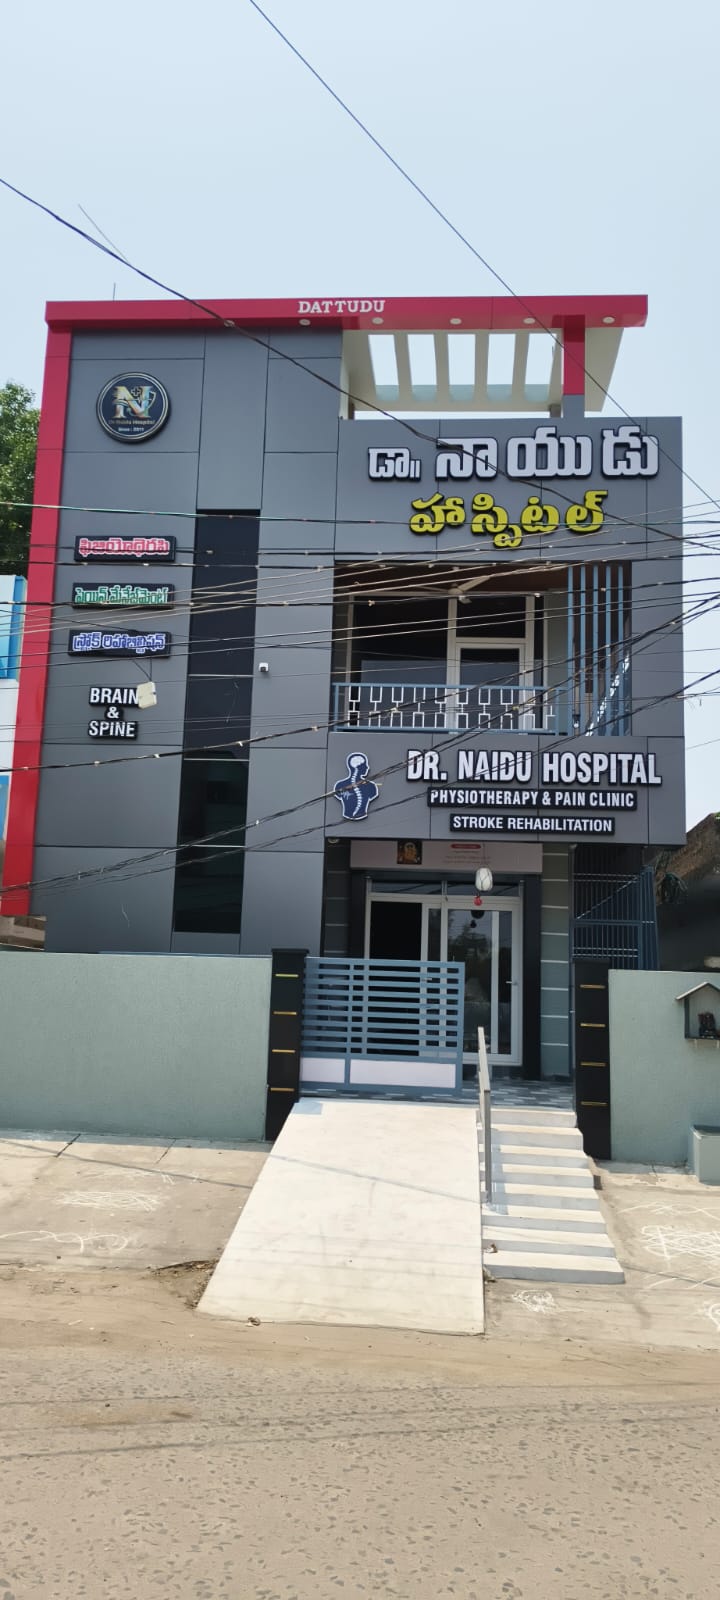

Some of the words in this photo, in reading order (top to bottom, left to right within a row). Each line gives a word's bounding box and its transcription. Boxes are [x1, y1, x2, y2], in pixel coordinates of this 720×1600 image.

[298, 300, 386, 313] DATTUDU
[436, 425, 660, 478] నాయుడు
[409, 490, 608, 548] హాస్పిటల్
[90, 687, 139, 704] BRAIN
[107, 706, 119, 719] &
[88, 720, 136, 737] SPINE
[407, 751, 448, 781] DR.
[458, 751, 532, 782] NAIDU
[543, 752, 662, 785] HOSPITAL
[430, 789, 539, 806] PHYSIOTHERAPY
[542, 790, 551, 806] &
[555, 791, 586, 806] PAIN
[590, 792, 634, 807] CLINIC
[453, 816, 504, 829] STROKE
[508, 817, 613, 832] REHABILITATION
